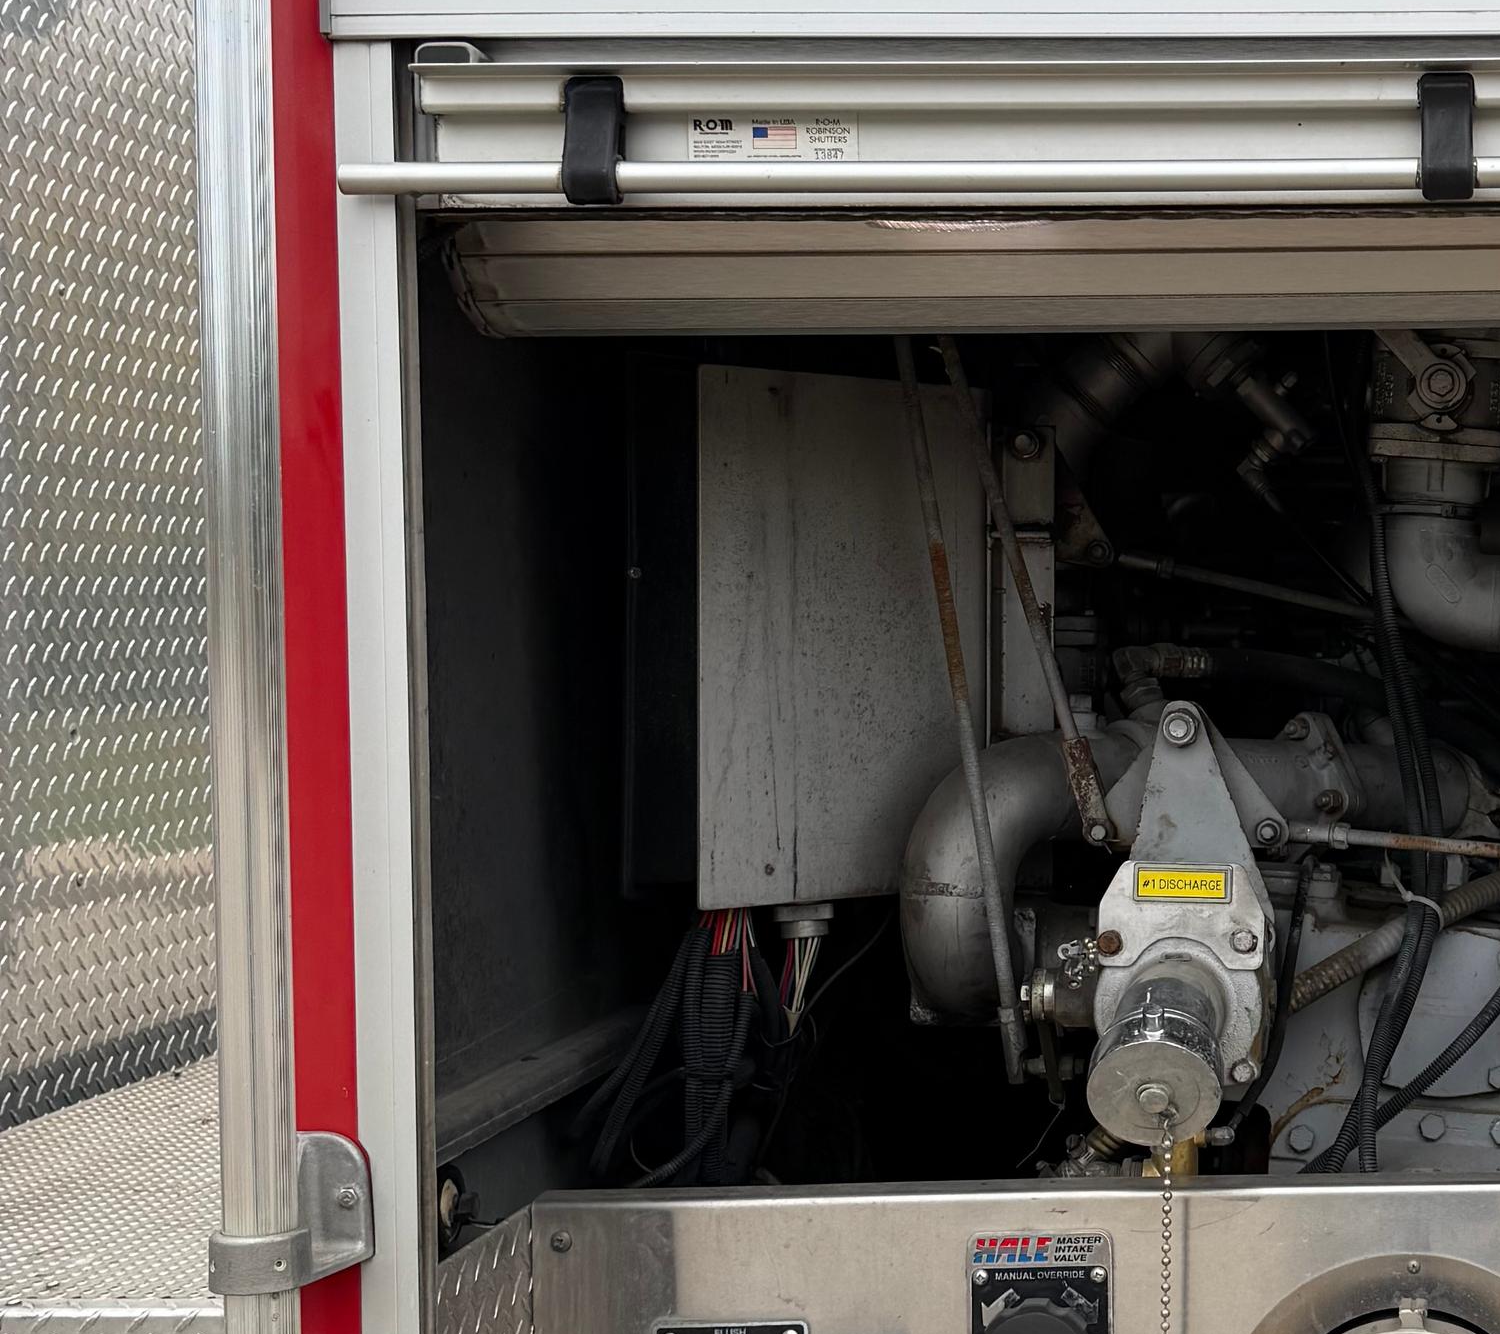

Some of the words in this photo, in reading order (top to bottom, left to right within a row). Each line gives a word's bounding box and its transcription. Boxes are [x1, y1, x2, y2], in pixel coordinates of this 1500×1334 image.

[806, 127, 851, 135] ROBINSON
[809, 136, 848, 144] SHUTTERS
[1159, 880, 1222, 891] DISCHARGE
[1057, 1236, 1102, 1244] MASTER
[973, 1237, 1052, 1264] HALE
[1055, 1245, 1094, 1253] INTAKE
[1053, 1254, 1087, 1262] VALVE
[995, 1271, 1035, 1280] MANUAL
[1037, 1270, 1085, 1279] OVERRIDE
